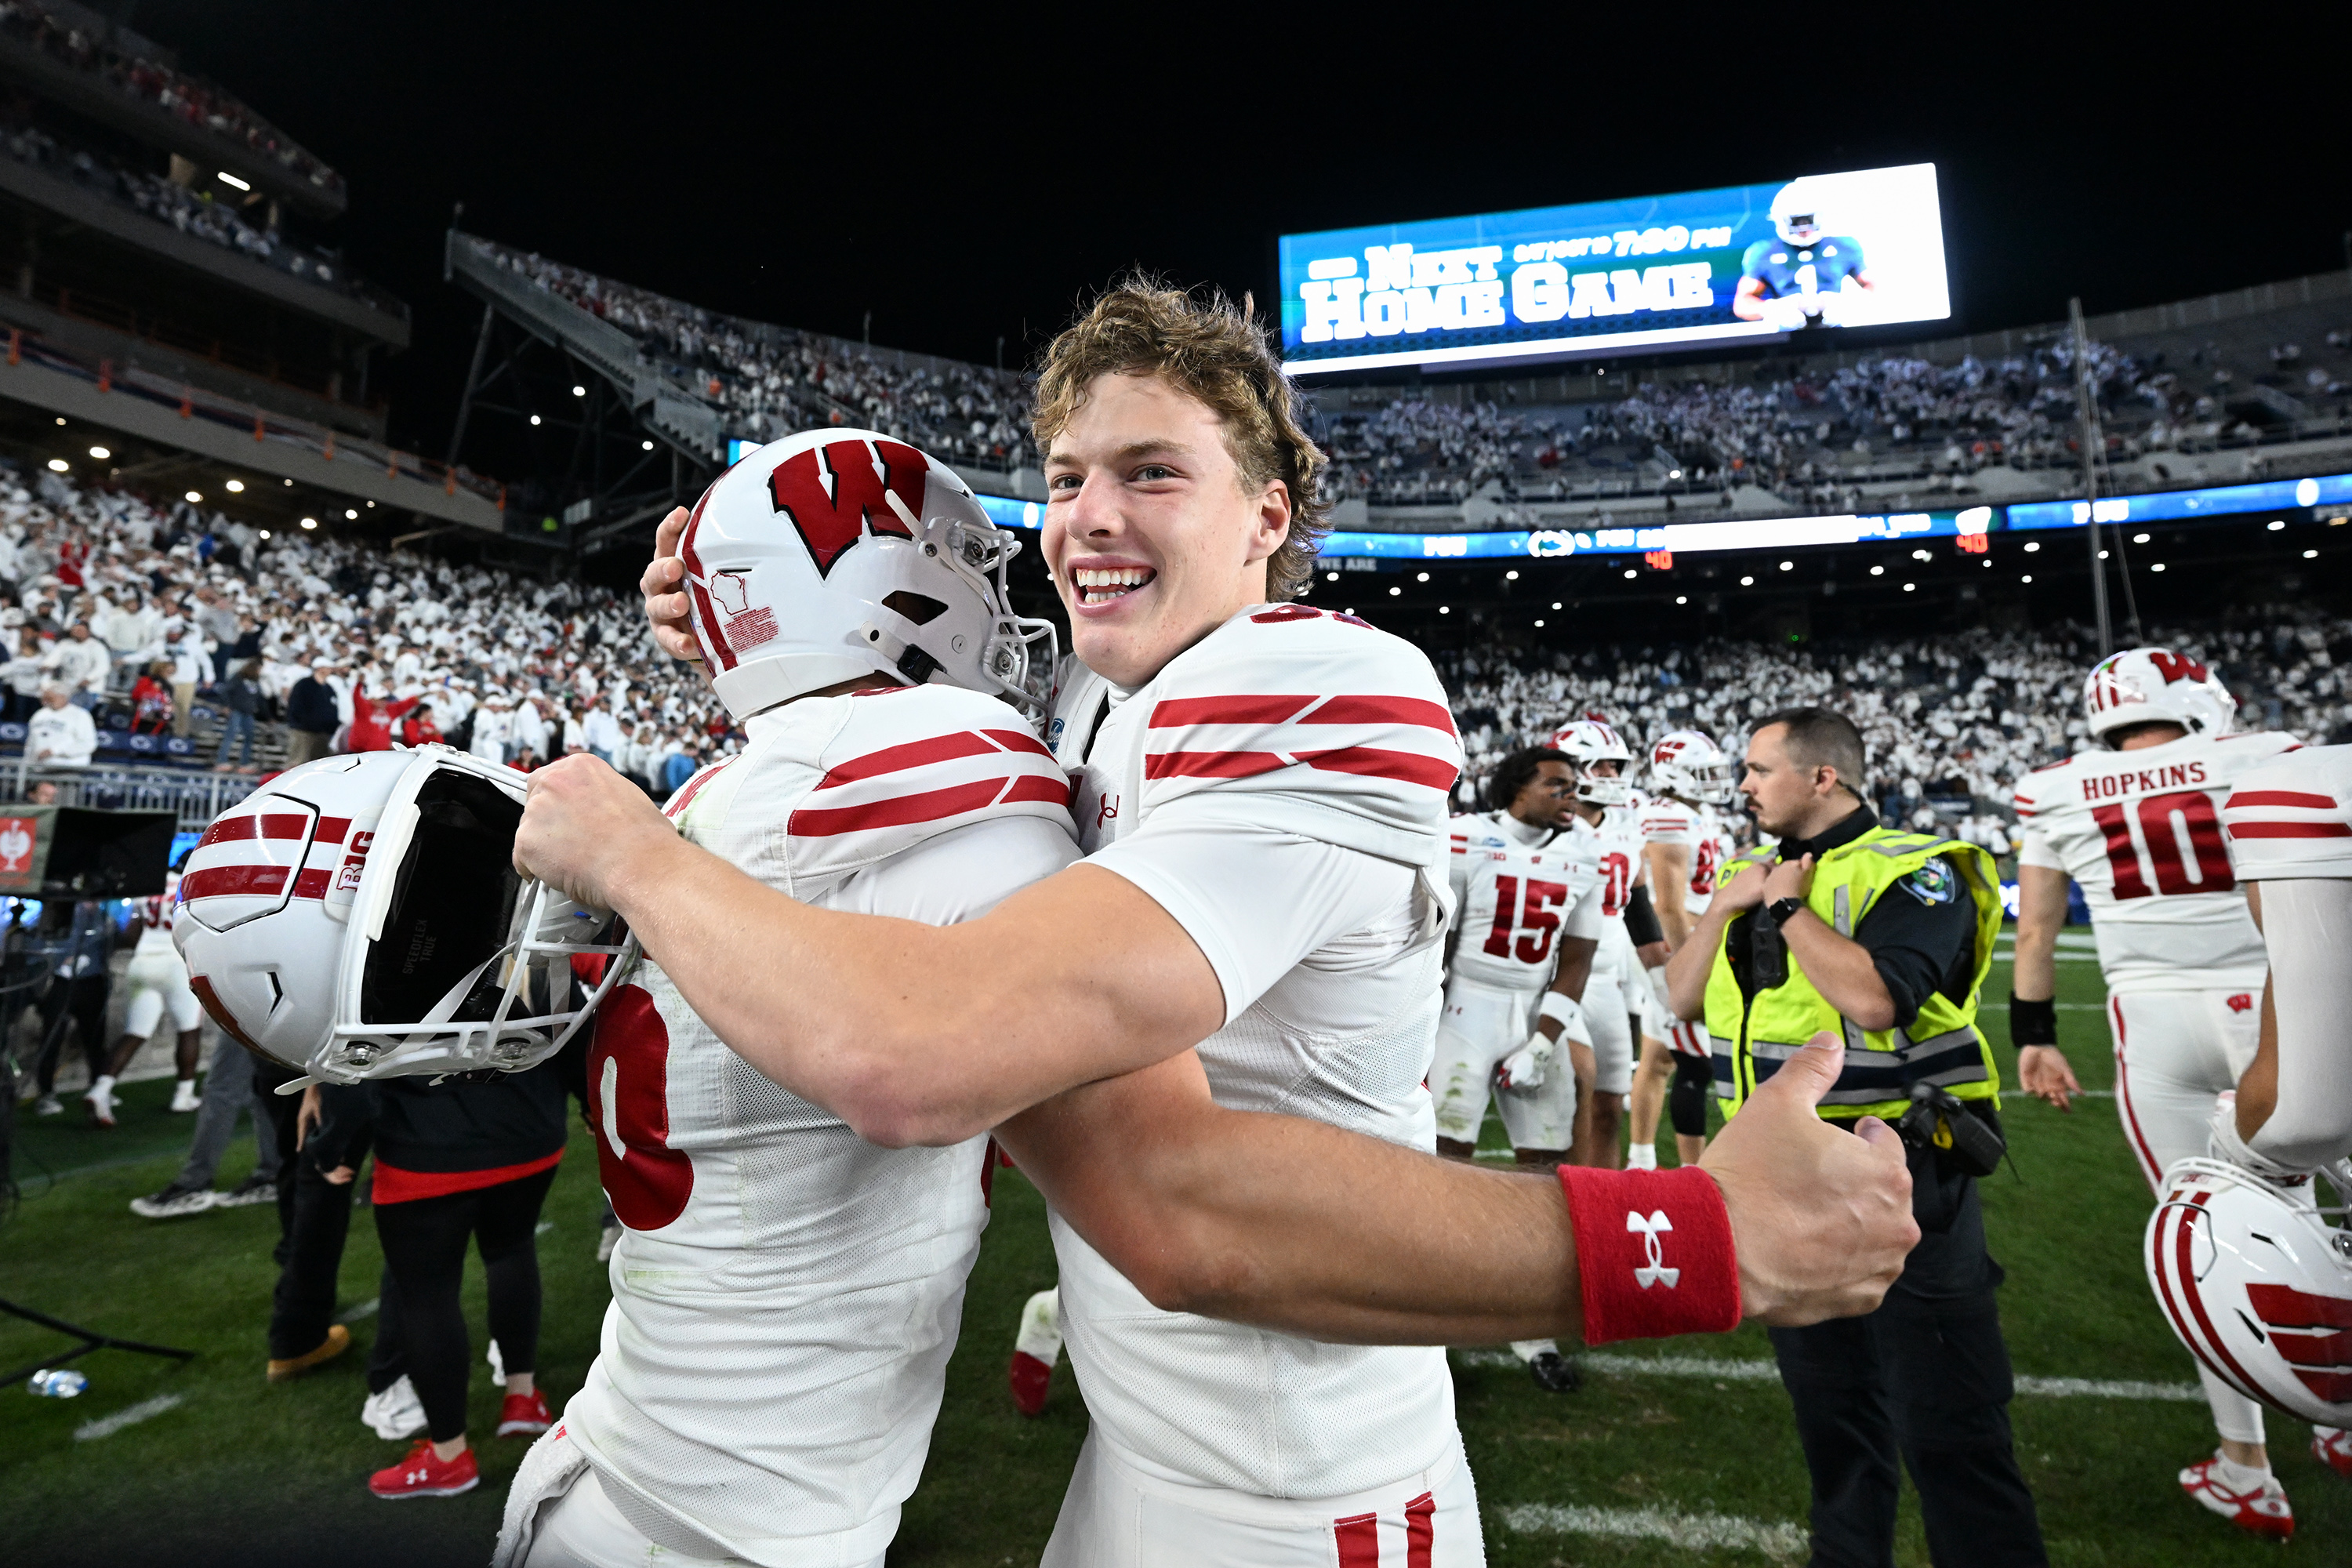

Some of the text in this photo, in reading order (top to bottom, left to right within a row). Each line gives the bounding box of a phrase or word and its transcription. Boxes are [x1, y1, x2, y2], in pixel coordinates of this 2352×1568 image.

[1364, 243, 1503, 292] NEXT
[1300, 261, 1714, 343] HOME GAME
[1645, 550, 1672, 570] 40
[1956, 532, 1988, 553] 40
[2082, 761, 2207, 800] HOPKINS
[2092, 790, 2234, 900] 10
[1483, 873, 1567, 964] 15
